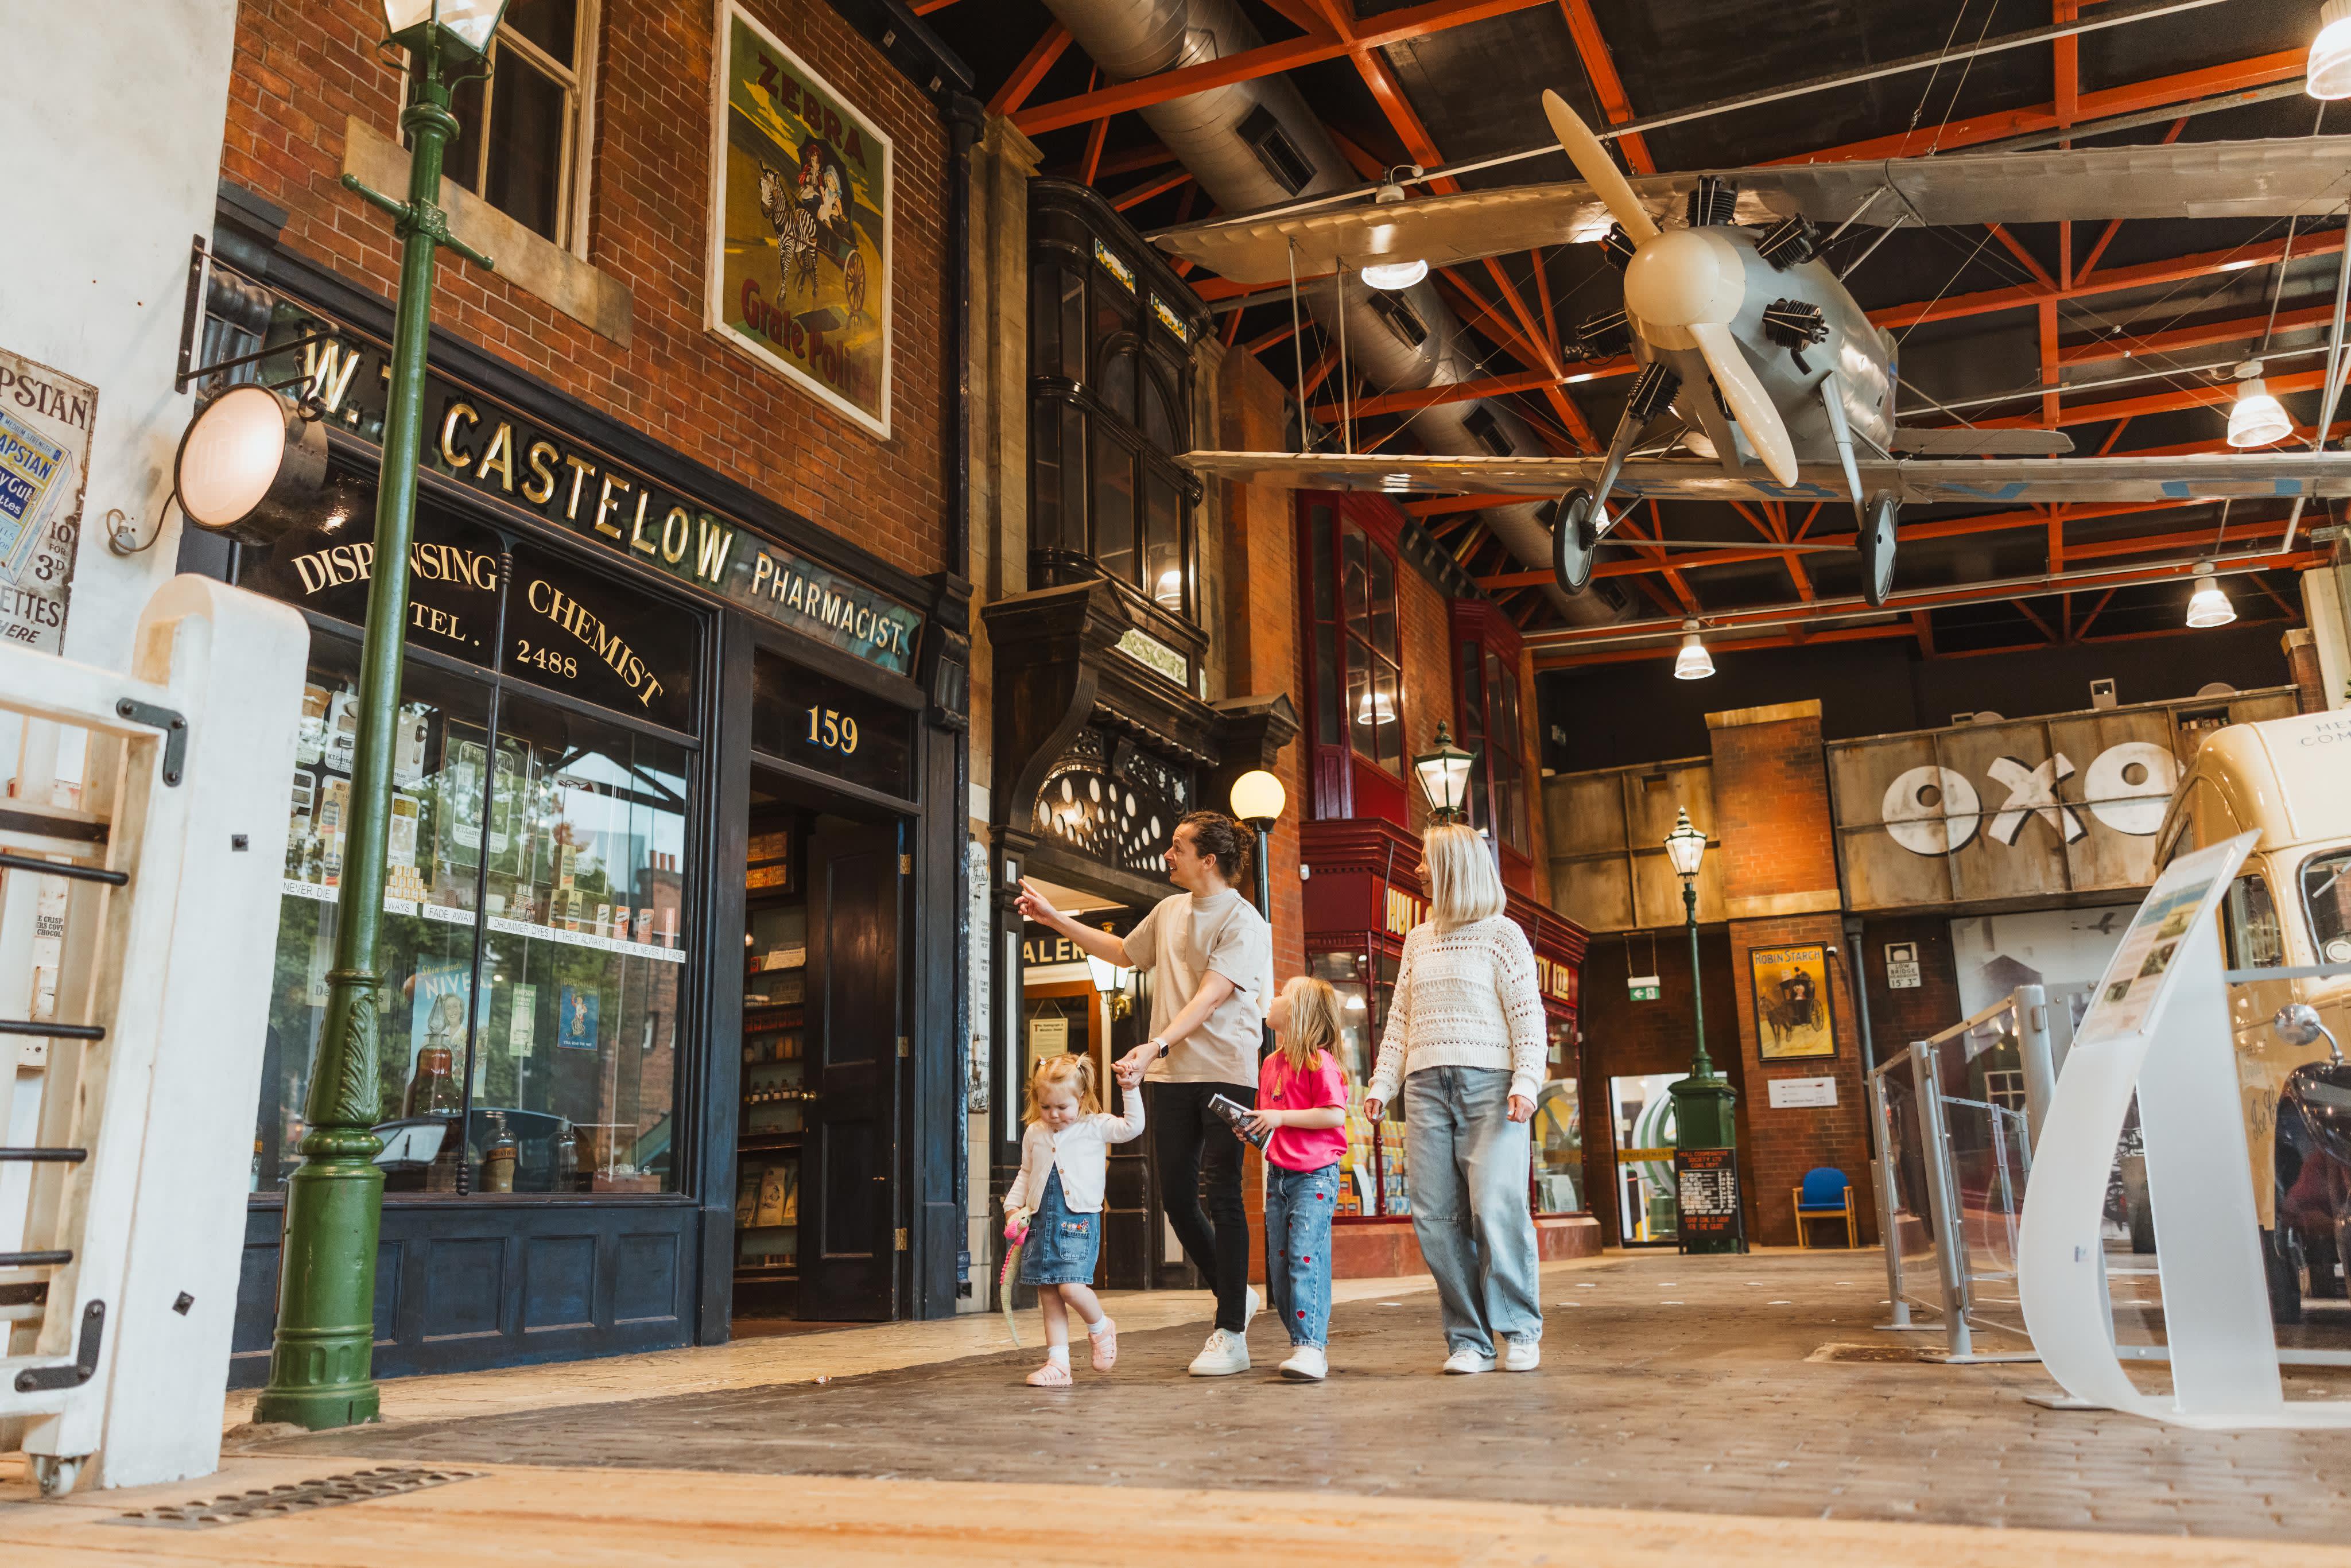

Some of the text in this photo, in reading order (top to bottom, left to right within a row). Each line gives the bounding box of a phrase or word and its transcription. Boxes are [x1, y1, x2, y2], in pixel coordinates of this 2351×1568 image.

[757, 51, 866, 171] ZEBRA
[742, 278, 806, 359] Grate
[4, 418, 52, 453] MEDIUM STRENGTH
[441, 403, 732, 583] CASTELOW
[49, 521, 71, 543] 10
[49, 544, 66, 556] FOR
[292, 542, 498, 596] DISPNSING
[517, 640, 578, 680] 2488
[528, 580, 663, 708] CHEMIST
[807, 704, 858, 755] 159
[1882, 742, 2186, 857] OXO
[283, 881, 331, 898] NEVER DIE
[44, 916, 63, 925] CRISP
[429, 907, 449, 919] FADE
[494, 919, 529, 933] DRUMMER
[532, 926, 549, 937] DYES
[562, 932, 577, 942] THEY
[581, 936, 606, 947] ALWAYS
[616, 942, 629, 951] DYE
[641, 946, 659, 956] NEVER
[669, 951, 684, 961] FADE
[1755, 950, 1821, 965] ROBIN STARCH
[422, 962, 463, 976] Skin needs
[564, 978, 598, 988] DRUMMER
[1553, 963, 1569, 1000] LTD
